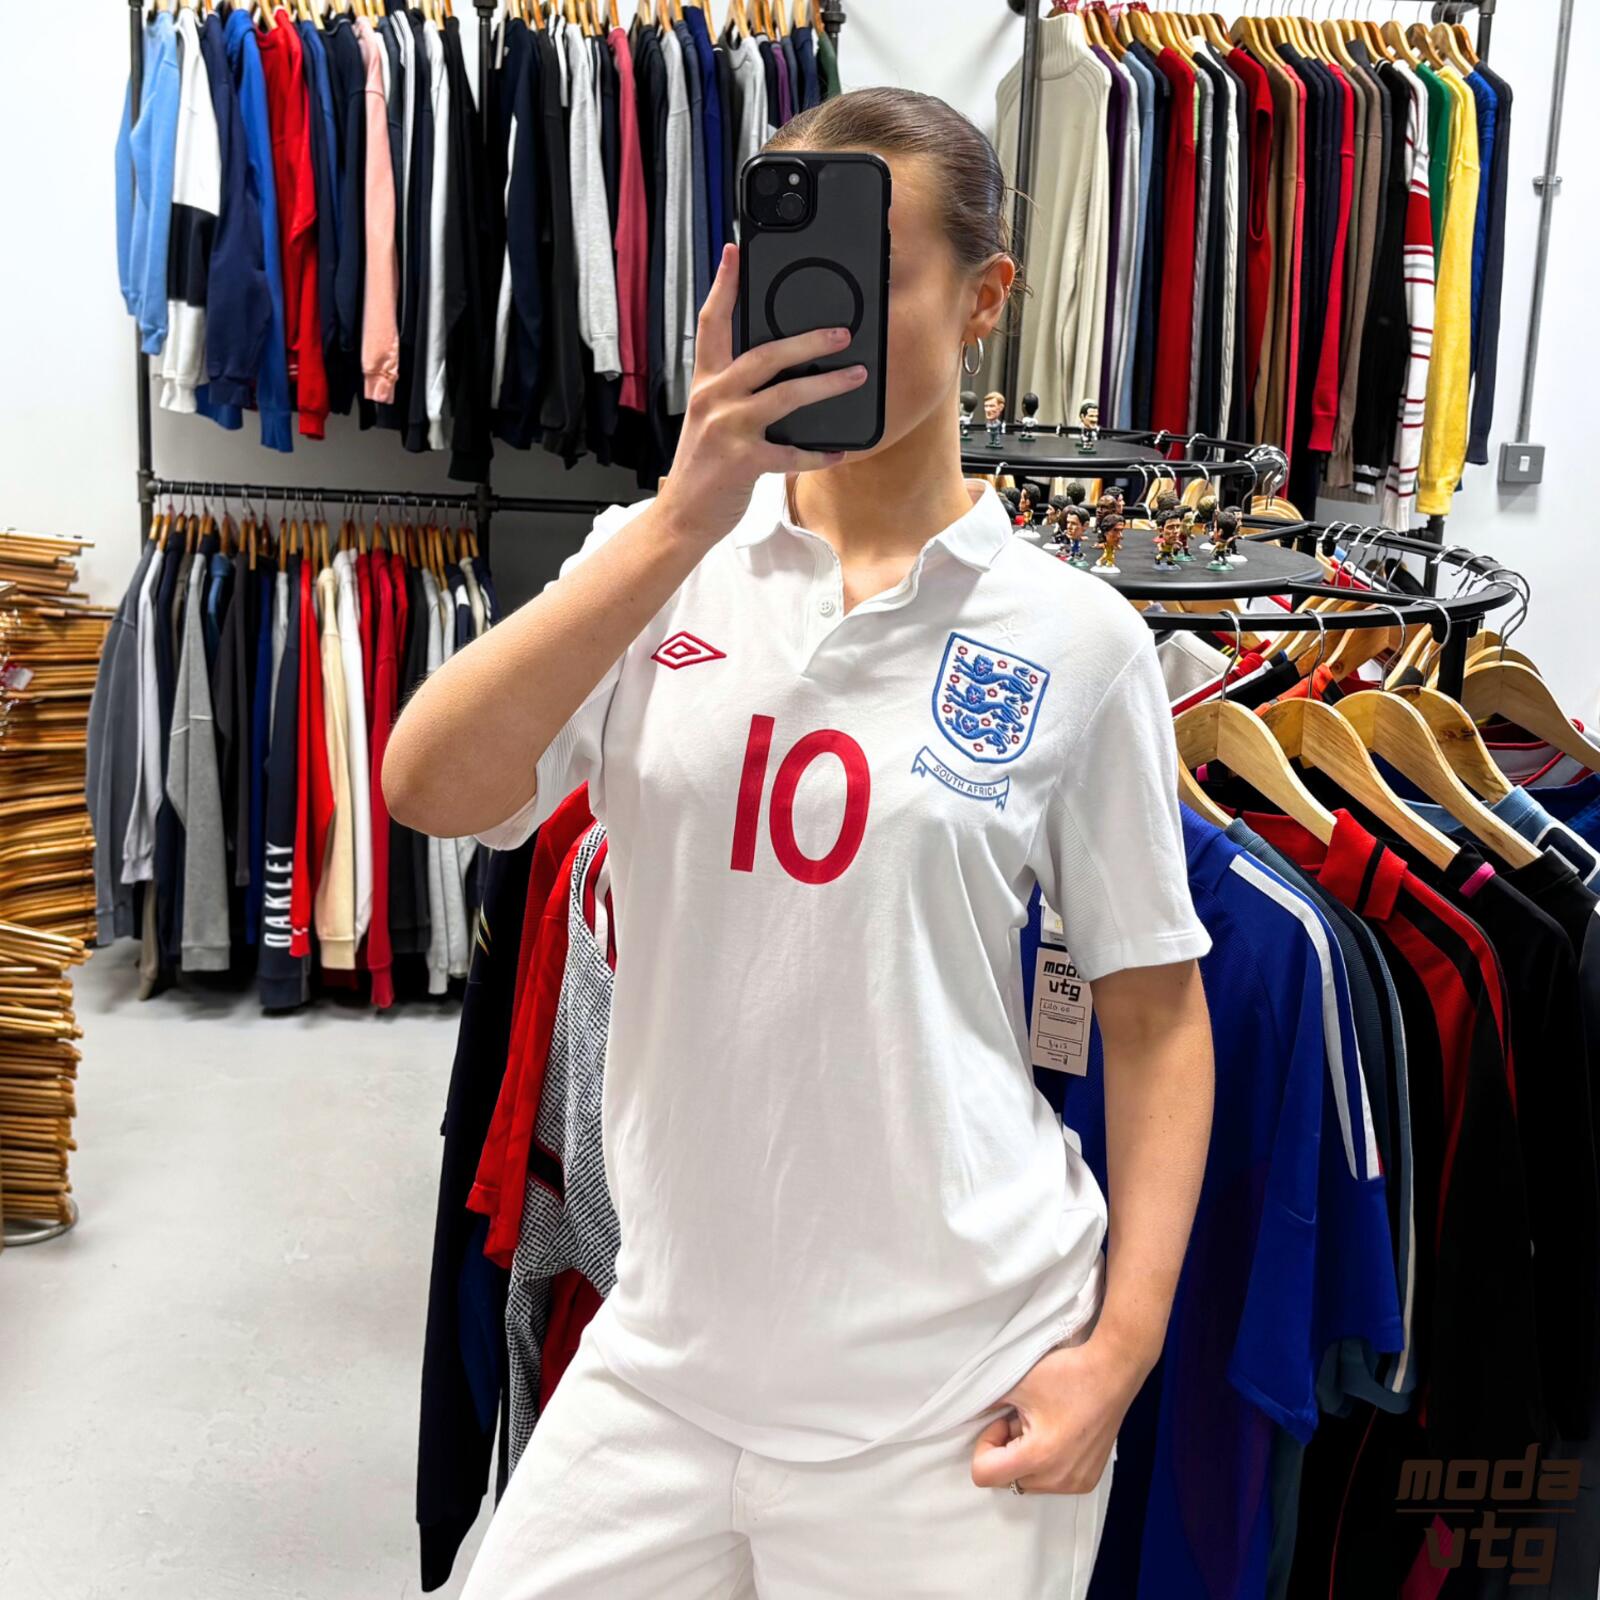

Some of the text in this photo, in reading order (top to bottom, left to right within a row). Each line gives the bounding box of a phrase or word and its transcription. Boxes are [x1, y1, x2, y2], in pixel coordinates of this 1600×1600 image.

[933, 764, 998, 796] SOUTH AFRICA
[730, 714, 871, 885] 10
[264, 841, 293, 948] OAKLEY
[1043, 960, 1081, 979] mod
[1049, 978, 1081, 1002] vtg
